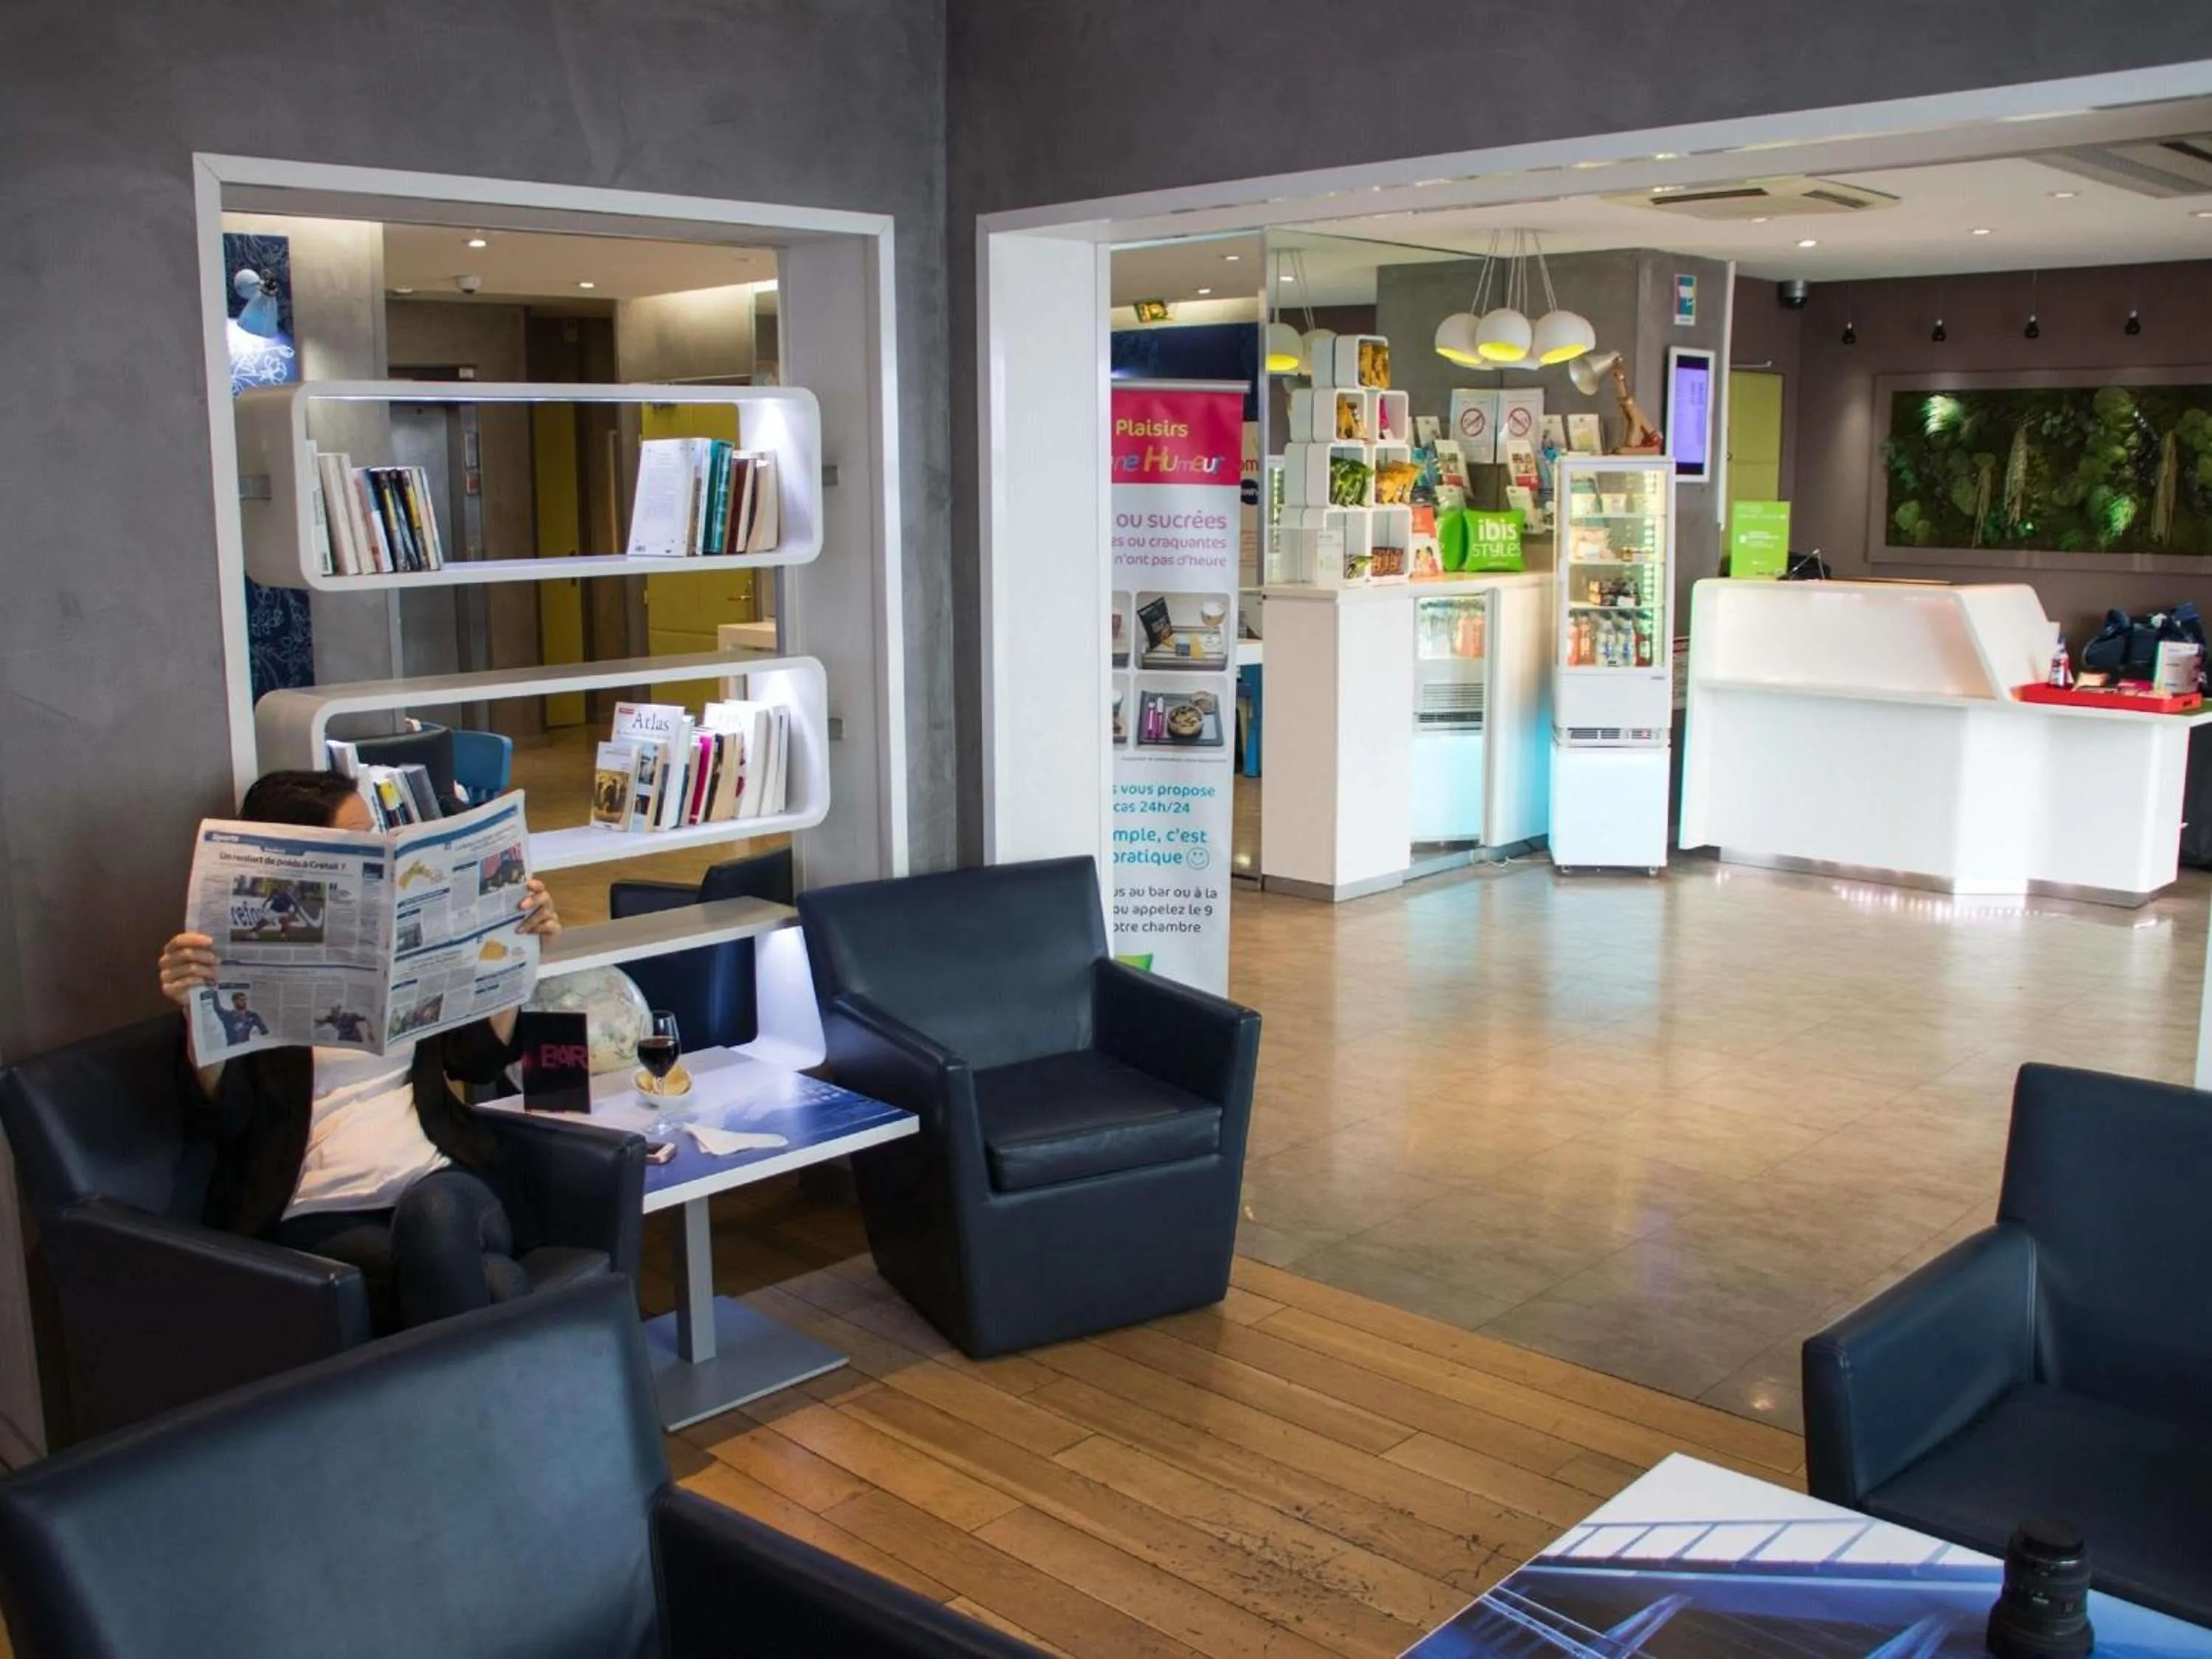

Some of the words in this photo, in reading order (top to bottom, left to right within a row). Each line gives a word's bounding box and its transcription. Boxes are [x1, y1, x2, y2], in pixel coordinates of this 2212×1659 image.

[1116, 419, 1189, 437] Plaisirs
[1147, 509, 1228, 529] sucrées
[1478, 518, 1517, 541] ibis
[1127, 537, 1146, 547] ou
[1148, 537, 1227, 550] craquantes
[1152, 554, 1175, 568] pas
[1177, 554, 1227, 568] d'heure
[631, 712, 669, 732] Atlas
[1120, 785, 1154, 796] vous
[1157, 785, 1216, 797] propose
[1113, 802, 1136, 813] cas
[1139, 801, 1191, 813] 24h/24
[1166, 828, 1208, 844] c'est
[1129, 888, 1144, 897] au
[1148, 886, 1170, 897] bar
[1173, 888, 1191, 898] ou
[1194, 886, 1202, 899] à
[1206, 888, 1218, 899] la
[1132, 903, 1186, 917] appelez
[1189, 904, 1201, 916] le
[1204, 905, 1213, 917] 9
[1142, 921, 1202, 933] chambre
